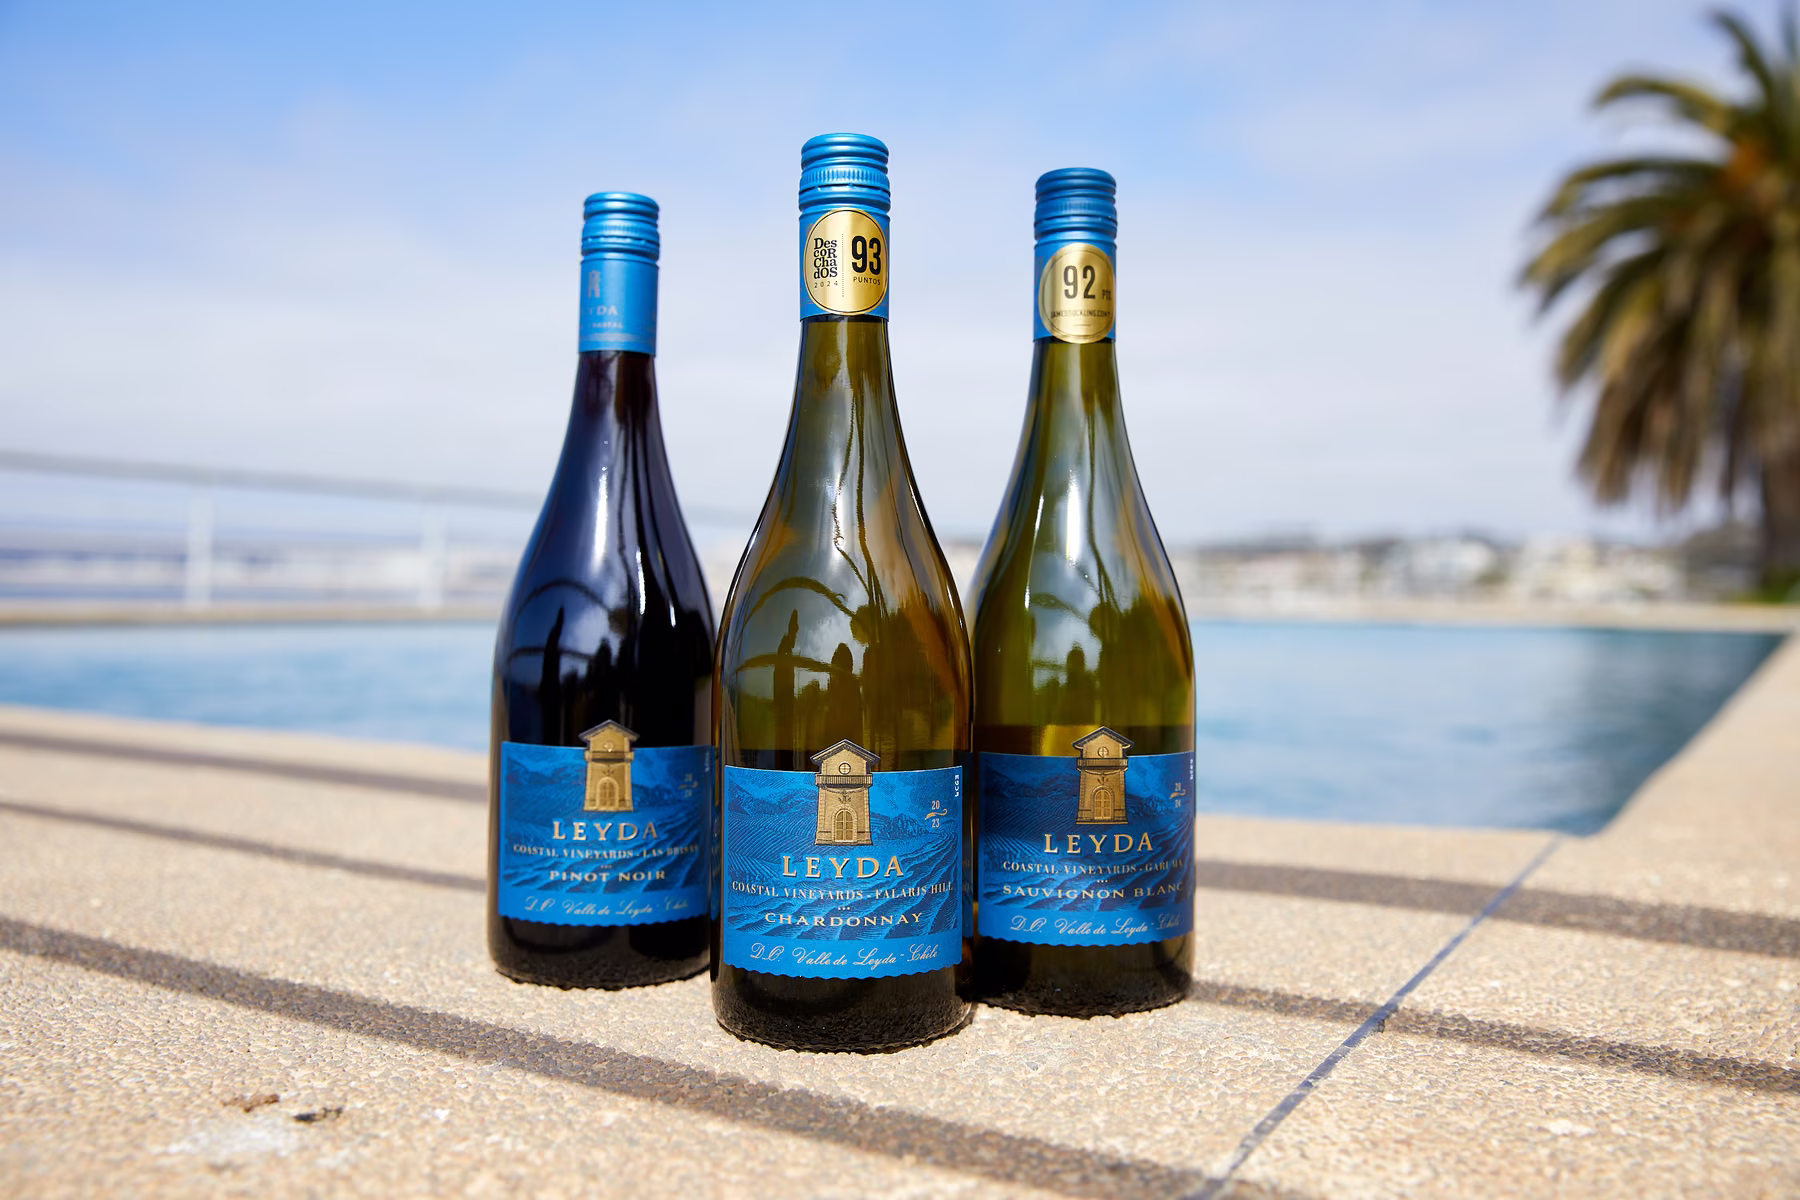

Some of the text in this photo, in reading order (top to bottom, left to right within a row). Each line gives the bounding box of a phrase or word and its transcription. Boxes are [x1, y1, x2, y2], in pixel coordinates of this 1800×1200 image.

[813, 237, 838, 250] Des
[851, 235, 882, 276] 93
[813, 280, 839, 289] 2024
[853, 276, 881, 286] PUNTOS
[1063, 265, 1096, 300] 92
[931, 800, 941, 810] 20
[552, 821, 659, 841] LEYDA
[931, 818, 941, 828] 23
[513, 843, 560, 858] COASTAL
[563, 847, 634, 859] VINEYARDS
[642, 847, 664, 858] LAS
[1043, 832, 1154, 854] LEYDA
[782, 855, 905, 878] LEYDA
[1003, 861, 1058, 875] COASTAL
[1063, 864, 1137, 875] VINEYARDS
[549, 870, 666, 882] PINOT NOIR
[732, 880, 779, 897] COASTAL
[784, 887, 864, 900] VINEYARDS
[875, 885, 927, 900] FALARIS
[931, 881, 954, 895] HILL
[1002, 881, 1184, 899] SAUVIGNON BLANC
[561, 899, 596, 915] Valle
[597, 904, 611, 915] de
[615, 899, 653, 919] Leyda
[764, 911, 923, 928] CHARDONNAY
[1054, 918, 1092, 935] Valle
[1092, 923, 1107, 935] de
[1110, 917, 1149, 938] Leyda
[791, 946, 832, 966] Valle
[832, 954, 849, 966] de
[852, 947, 897, 970] Leyda
[906, 943, 939, 962] Chile
